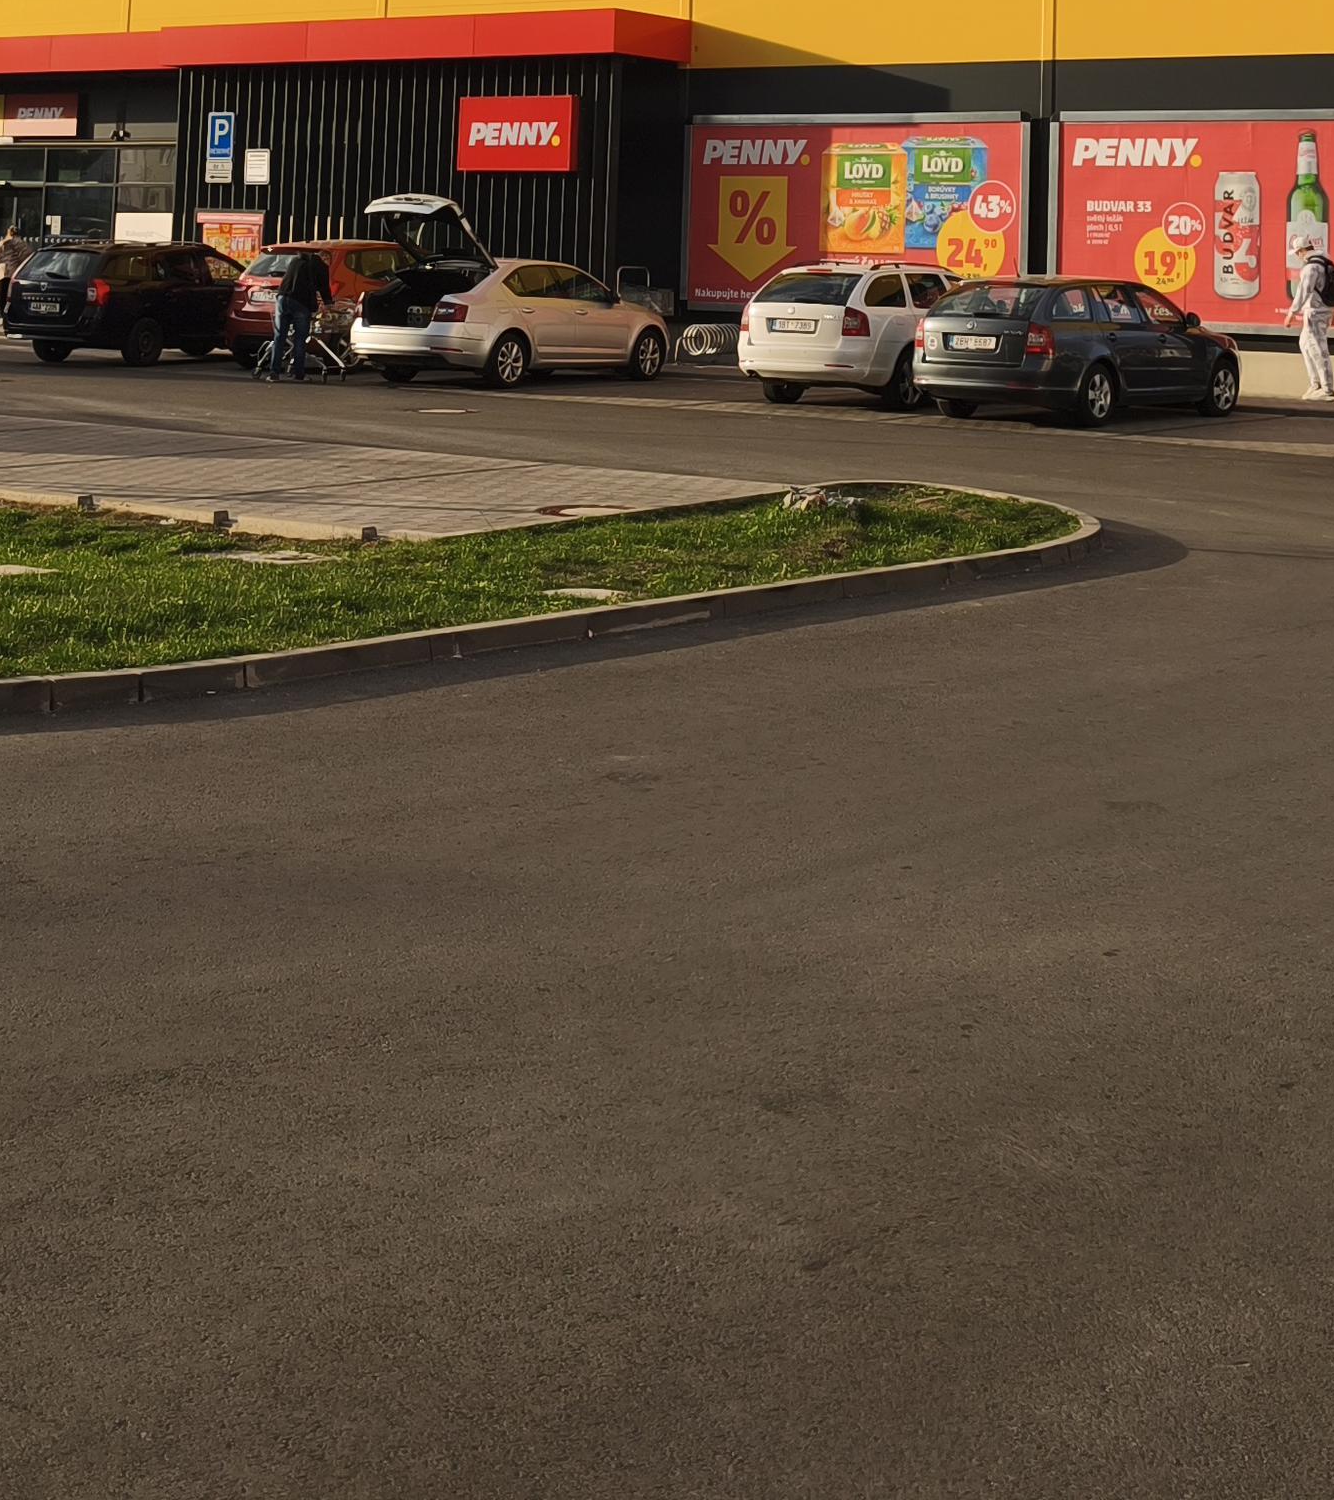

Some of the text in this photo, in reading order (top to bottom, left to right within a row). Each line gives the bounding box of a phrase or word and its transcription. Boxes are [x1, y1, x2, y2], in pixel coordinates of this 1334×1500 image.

[214, 119, 229, 145] P
[844, 161, 884, 181] LOYD
[921, 154, 964, 175] LOYD
[972, 193, 1012, 220] 43%
[1086, 200, 1152, 213] BUDVAR 33
[1167, 213, 1201, 236] 20%
[1222, 190, 1234, 274] BUDVAR
[695, 288, 739, 300] Nakupujte
